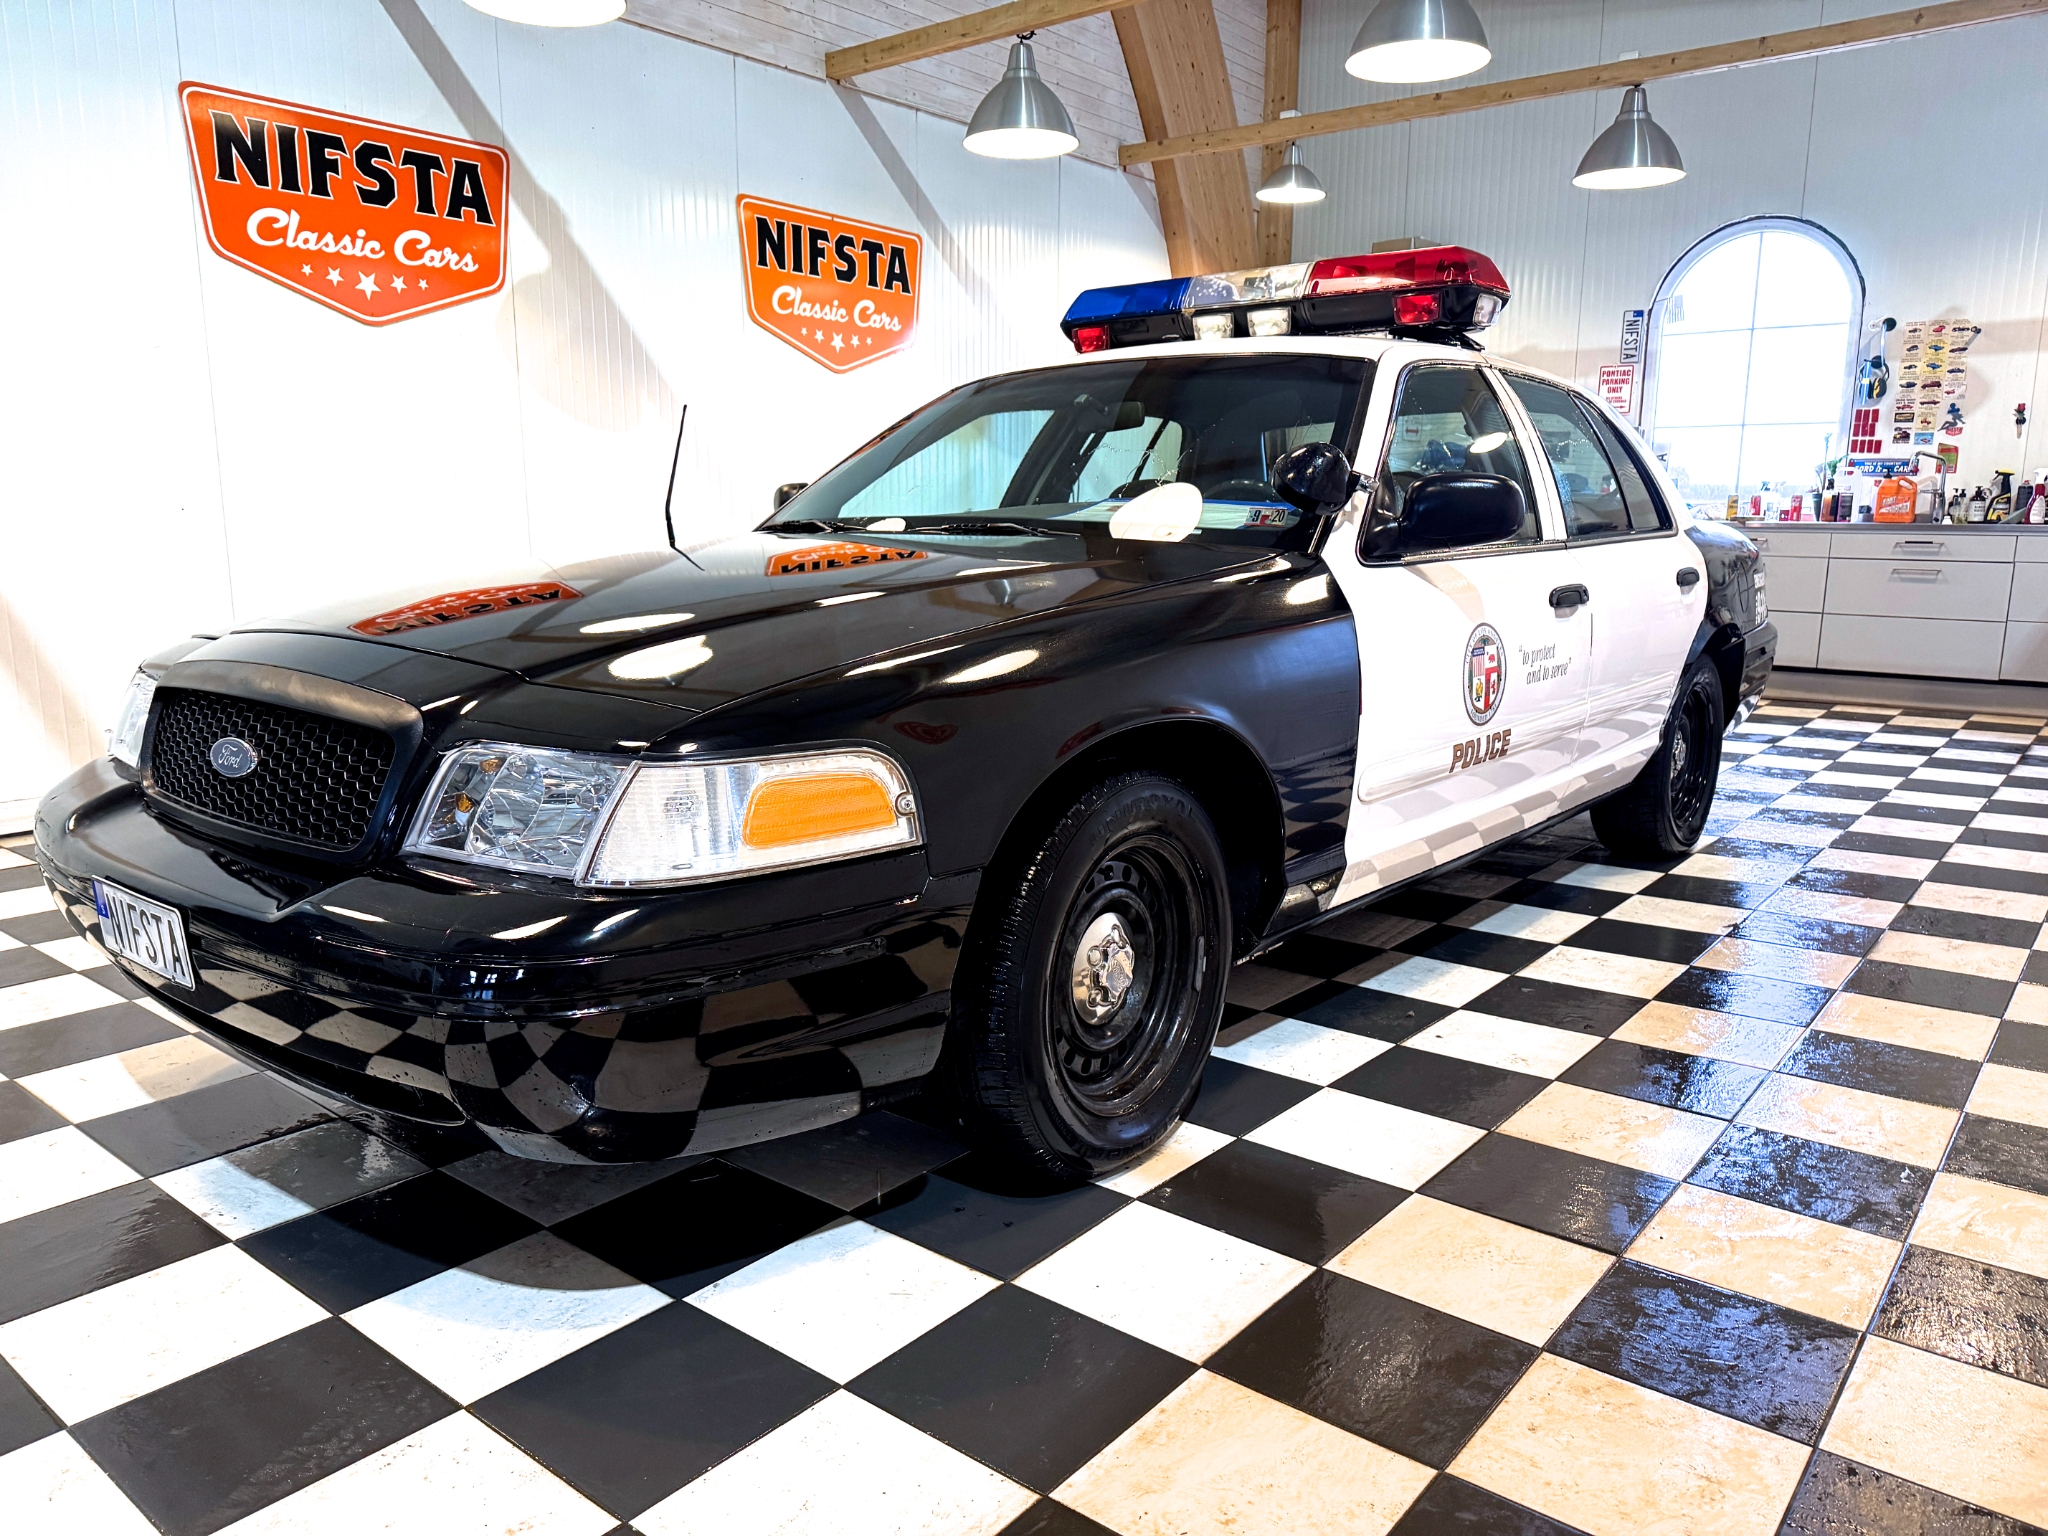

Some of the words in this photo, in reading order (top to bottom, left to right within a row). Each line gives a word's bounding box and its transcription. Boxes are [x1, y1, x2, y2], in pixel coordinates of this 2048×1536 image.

[208, 108, 496, 227] NIFSTA
[246, 207, 385, 259] Classic
[394, 229, 479, 273] Cars
[754, 214, 913, 296] NIFSTA
[771, 285, 849, 323] Classic
[853, 299, 902, 332] Cars
[1622, 319, 1640, 360] NIFSTA
[1601, 369, 1632, 378] PONTIAC
[1601, 378, 1630, 386] PARKING
[1607, 386, 1623, 394] ONLY
[1252, 509, 1261, 523] 9
[1271, 509, 1286, 523] 20
[1530, 643, 1556, 668] protect
[1526, 664, 1542, 686] and
[1542, 665, 1550, 681] to
[218, 743, 243, 769] Ford
[1448, 728, 1512, 774] POLICE
[105, 892, 187, 978] NIFSTA
